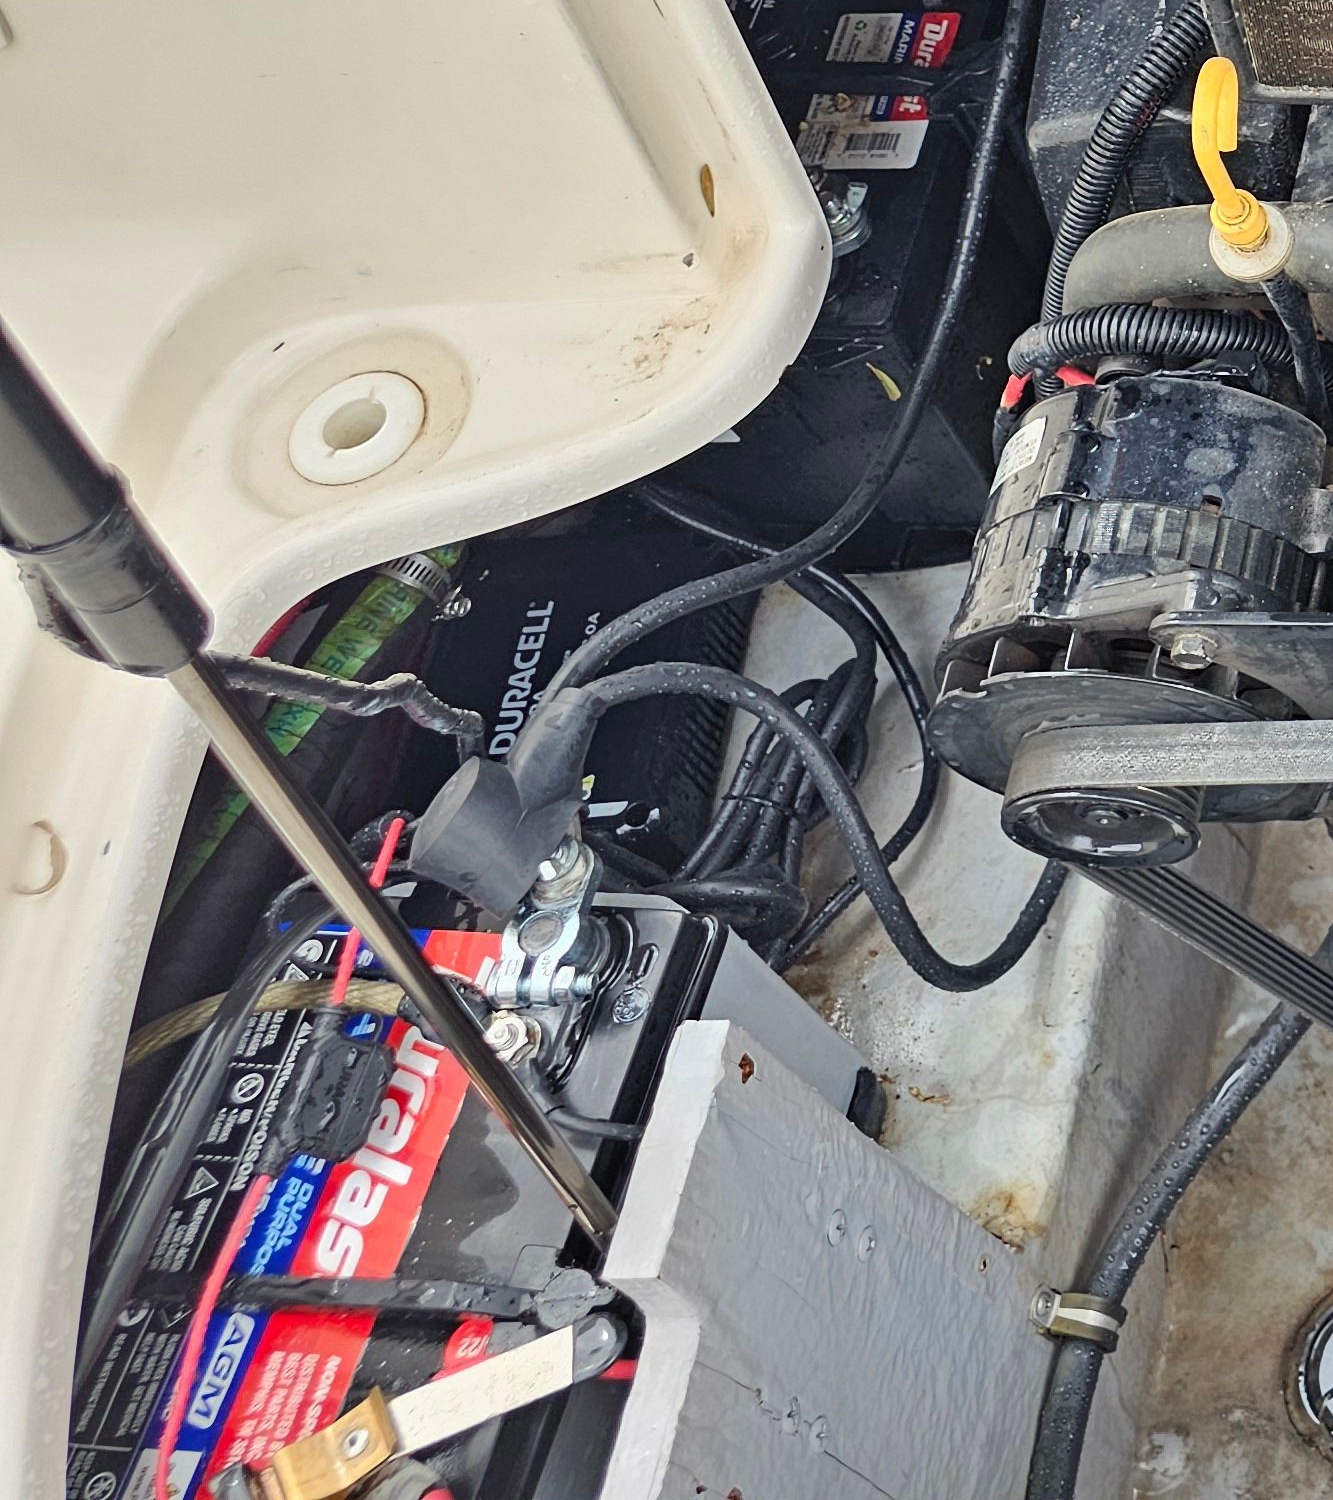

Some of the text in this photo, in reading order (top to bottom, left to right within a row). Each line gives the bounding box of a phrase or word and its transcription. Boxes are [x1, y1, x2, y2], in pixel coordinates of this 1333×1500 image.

[489, 600, 554, 755] DURACELL
[249, 1176, 302, 1278] PURPOS
[274, 1182, 315, 1252] DUAL
[193, 1316, 246, 1419] AGM
[273, 1353, 321, 1439] DISTRIBUTED
[278, 1352, 304, 1386] BEST
